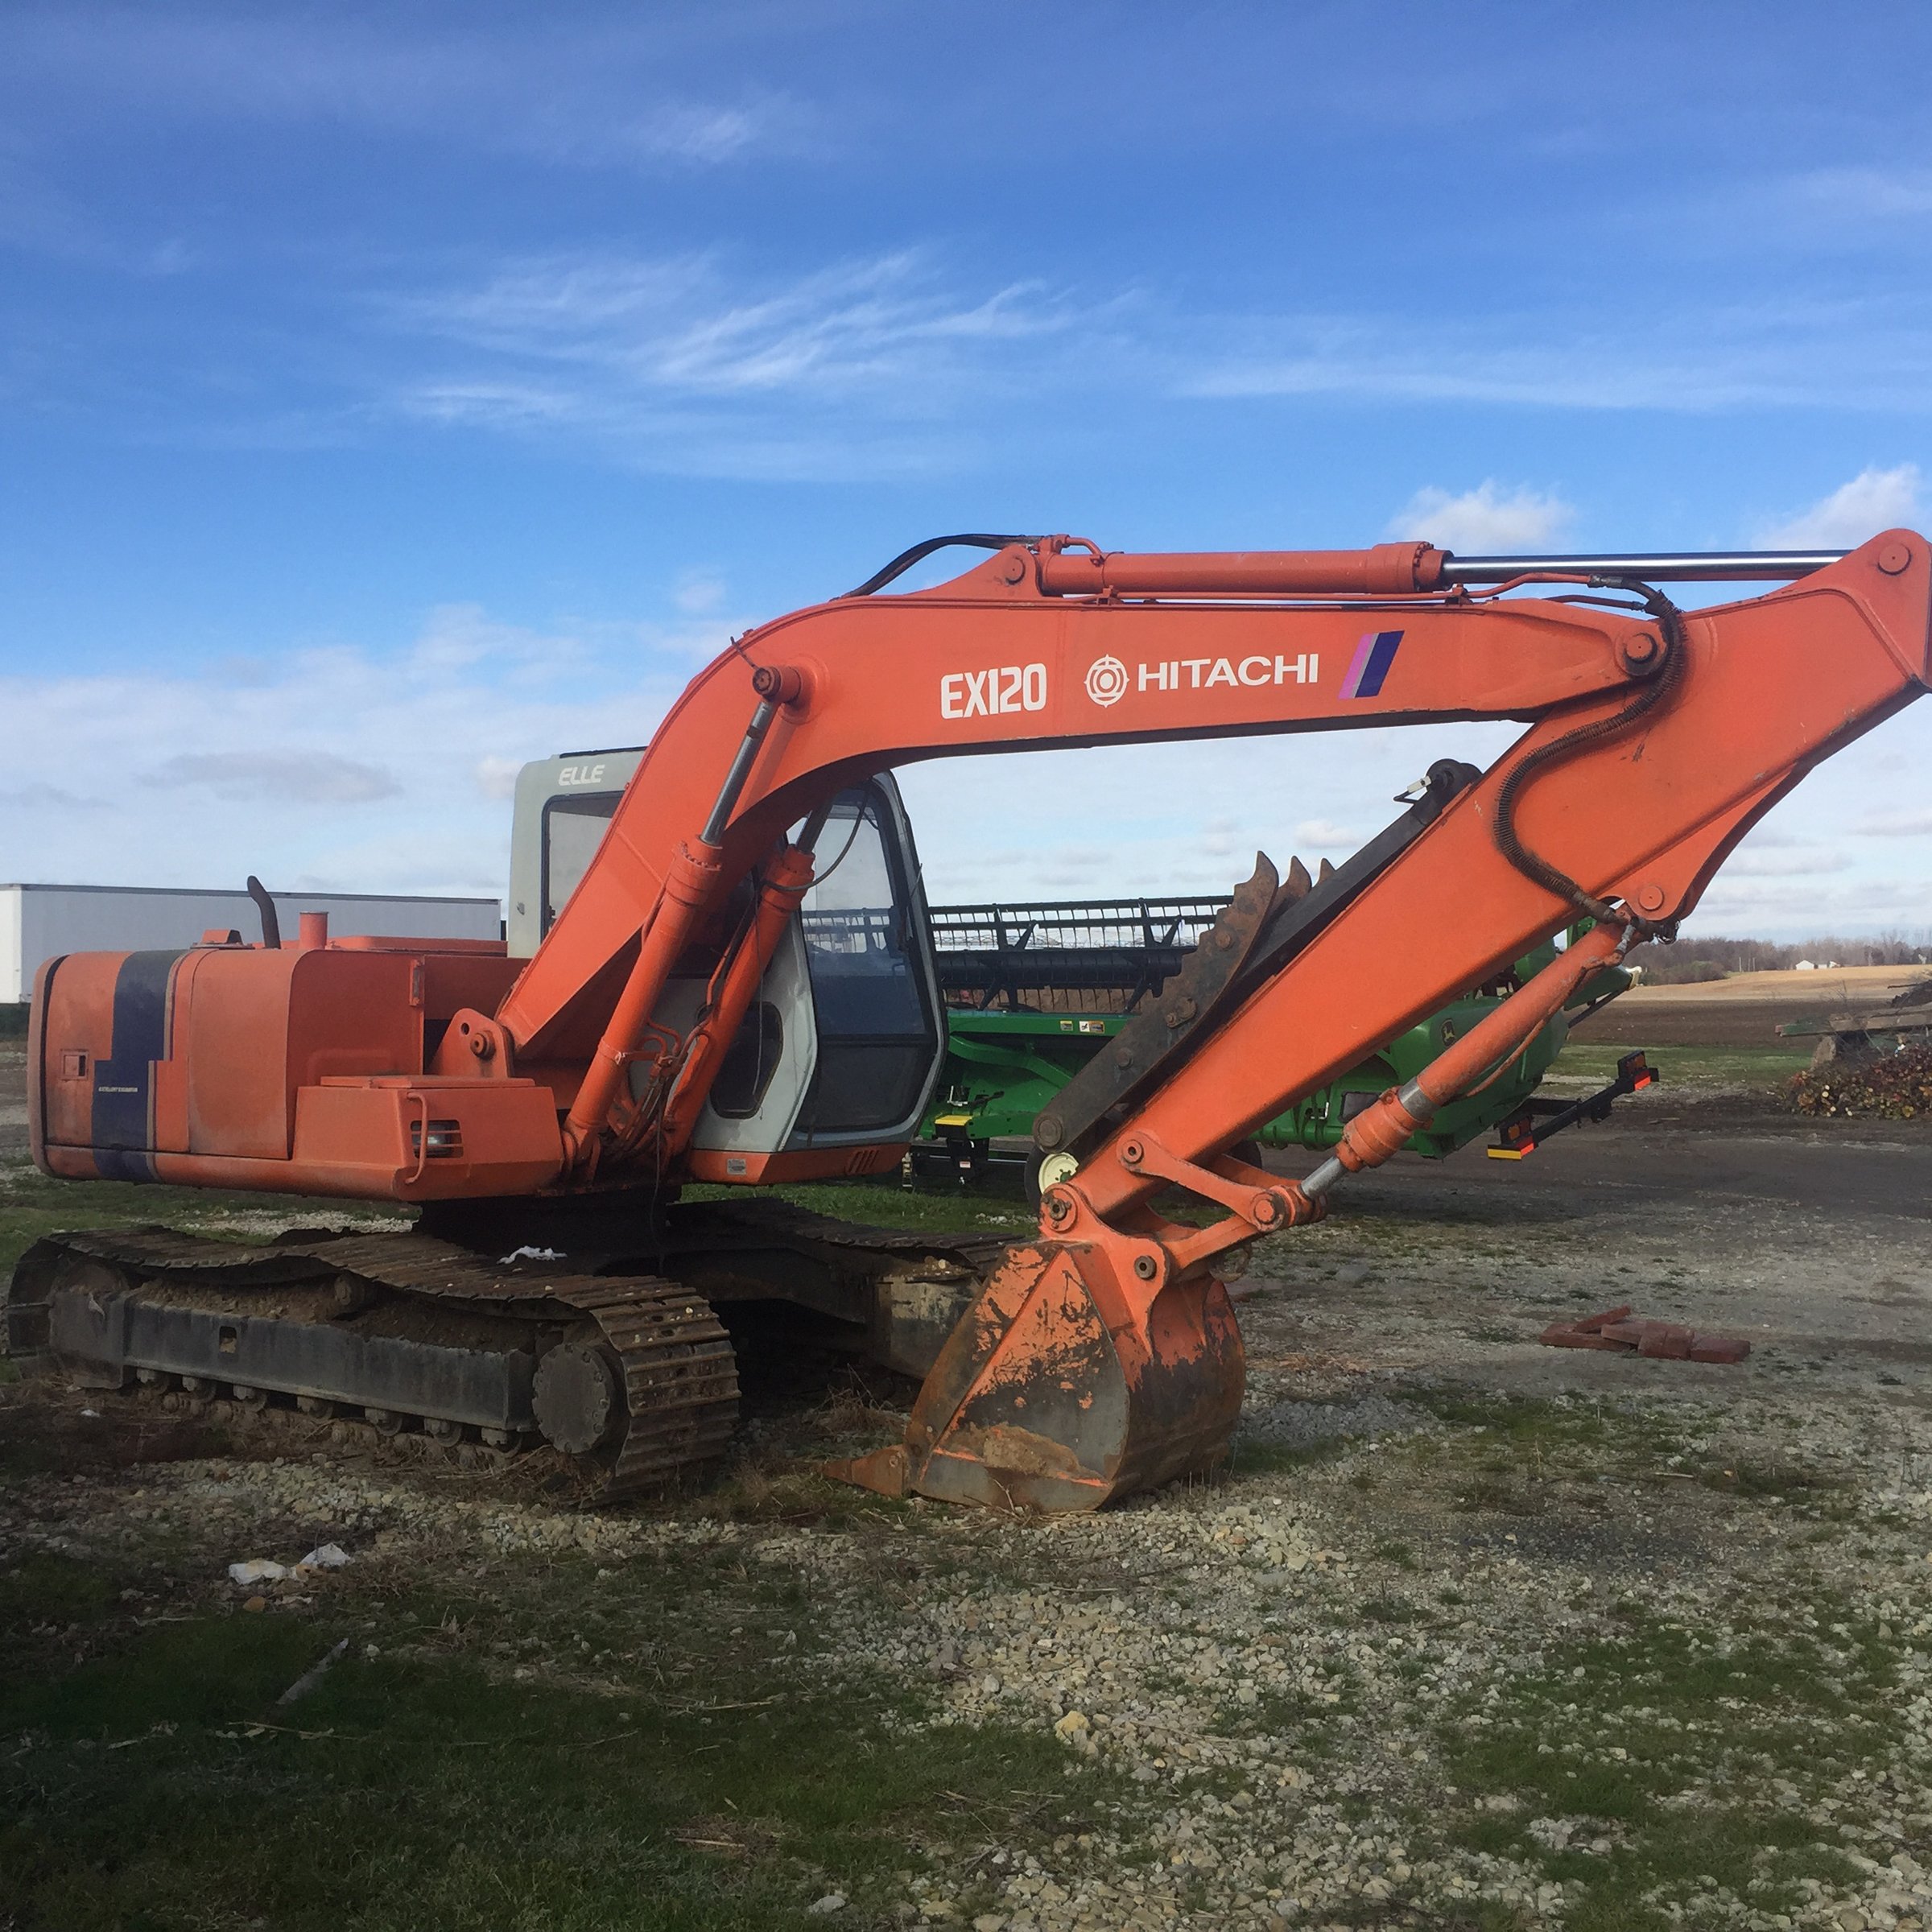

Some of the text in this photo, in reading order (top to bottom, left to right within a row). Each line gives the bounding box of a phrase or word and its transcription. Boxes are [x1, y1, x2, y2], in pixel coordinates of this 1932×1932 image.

[941, 663, 1046, 719] EX120
[1138, 654, 1319, 691] HITACHI
[558, 764, 605, 786] ELLE
